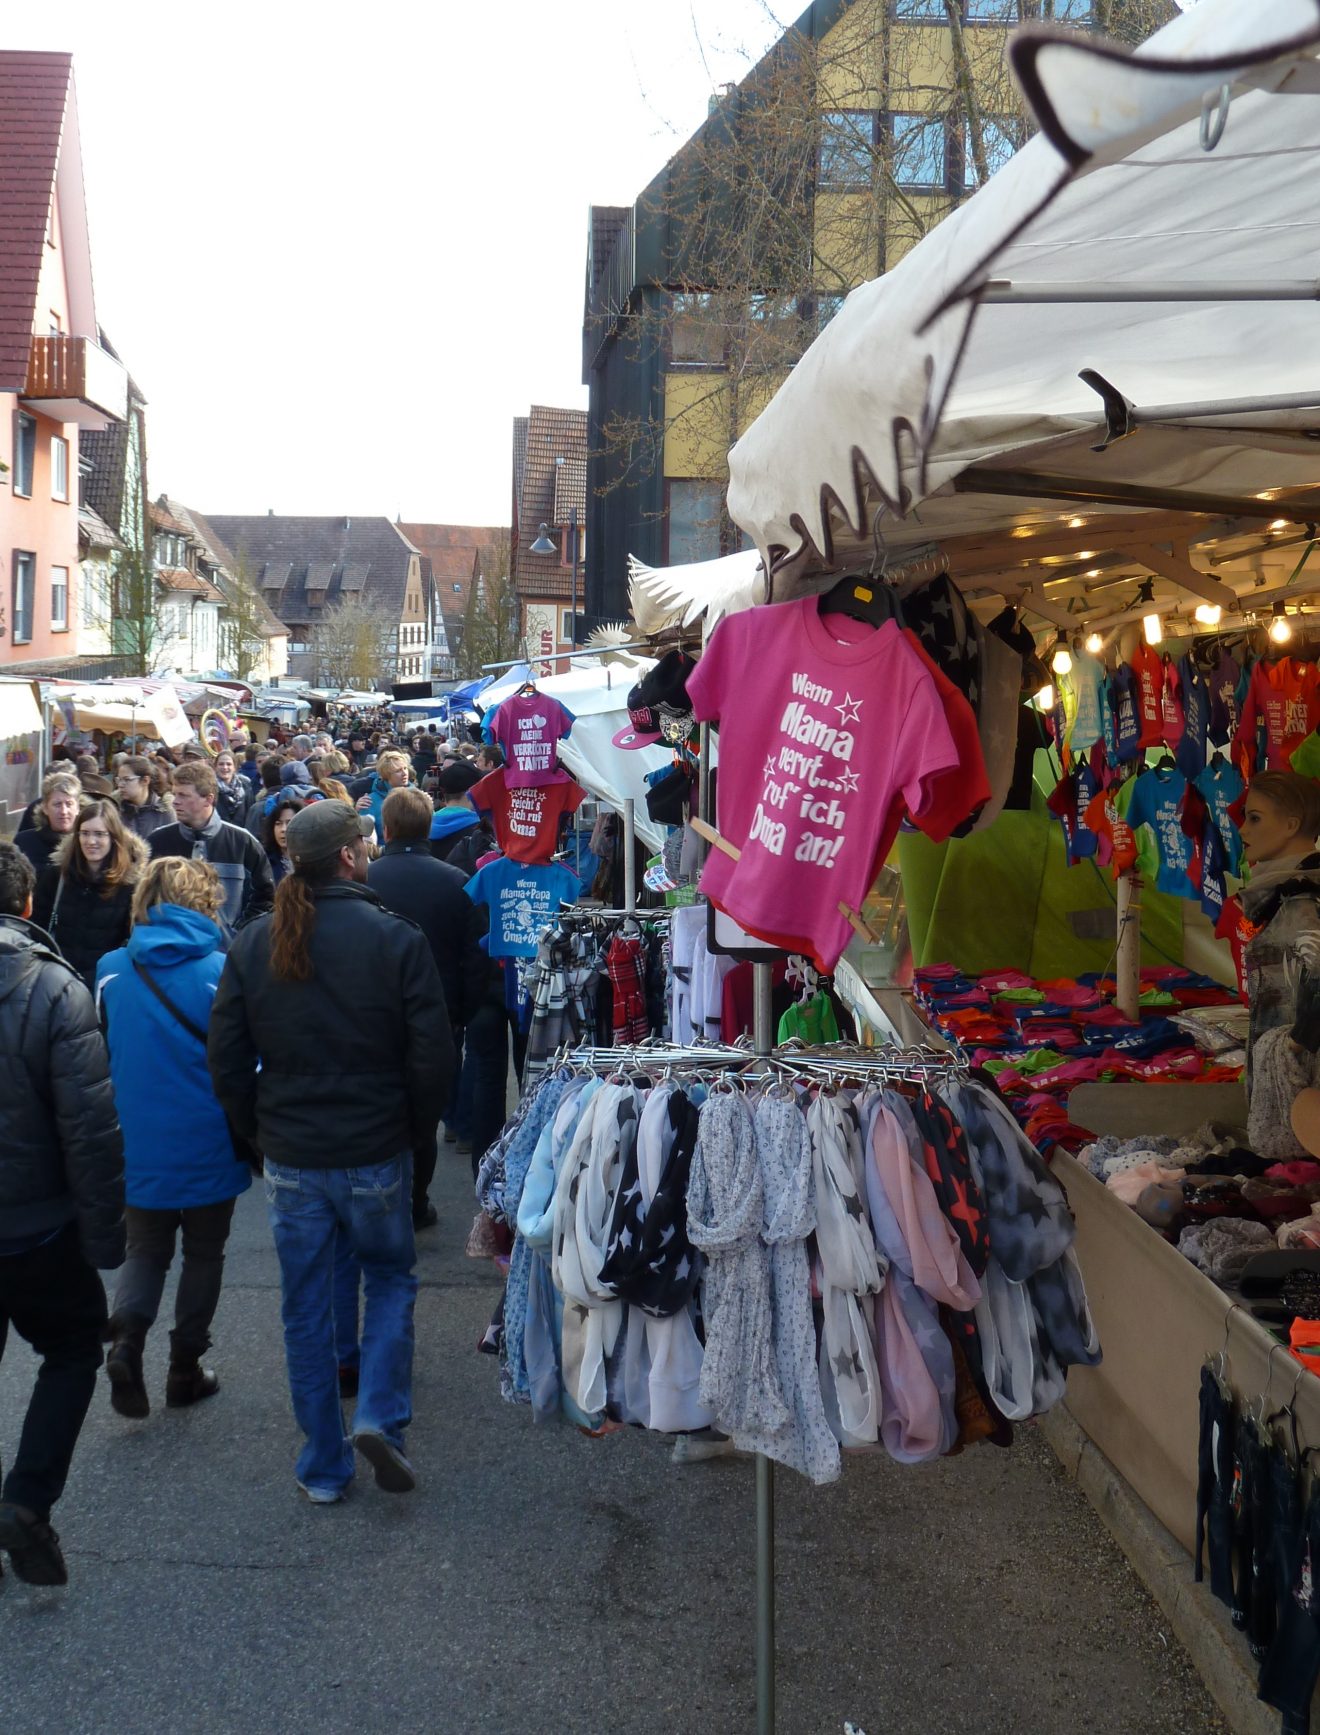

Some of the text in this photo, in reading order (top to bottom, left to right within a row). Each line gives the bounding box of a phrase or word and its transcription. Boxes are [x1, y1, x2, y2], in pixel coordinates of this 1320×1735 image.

[792, 672, 832, 706] Wenn
[518, 718, 532, 730] ICH
[780, 702, 854, 761] Mama
[520, 730, 542, 740] MEINE
[517, 756, 549, 771] TANTE
[512, 809, 542, 822] ich ruf
[800, 794, 846, 830] ich
[510, 819, 536, 836] Oma
[750, 804, 845, 868] Oma an!
[516, 879, 536, 888] Wenn
[500, 888, 550, 900] Mama+Papa
[502, 921, 514, 930] ich
[504, 930, 540, 946] Oma+Op
